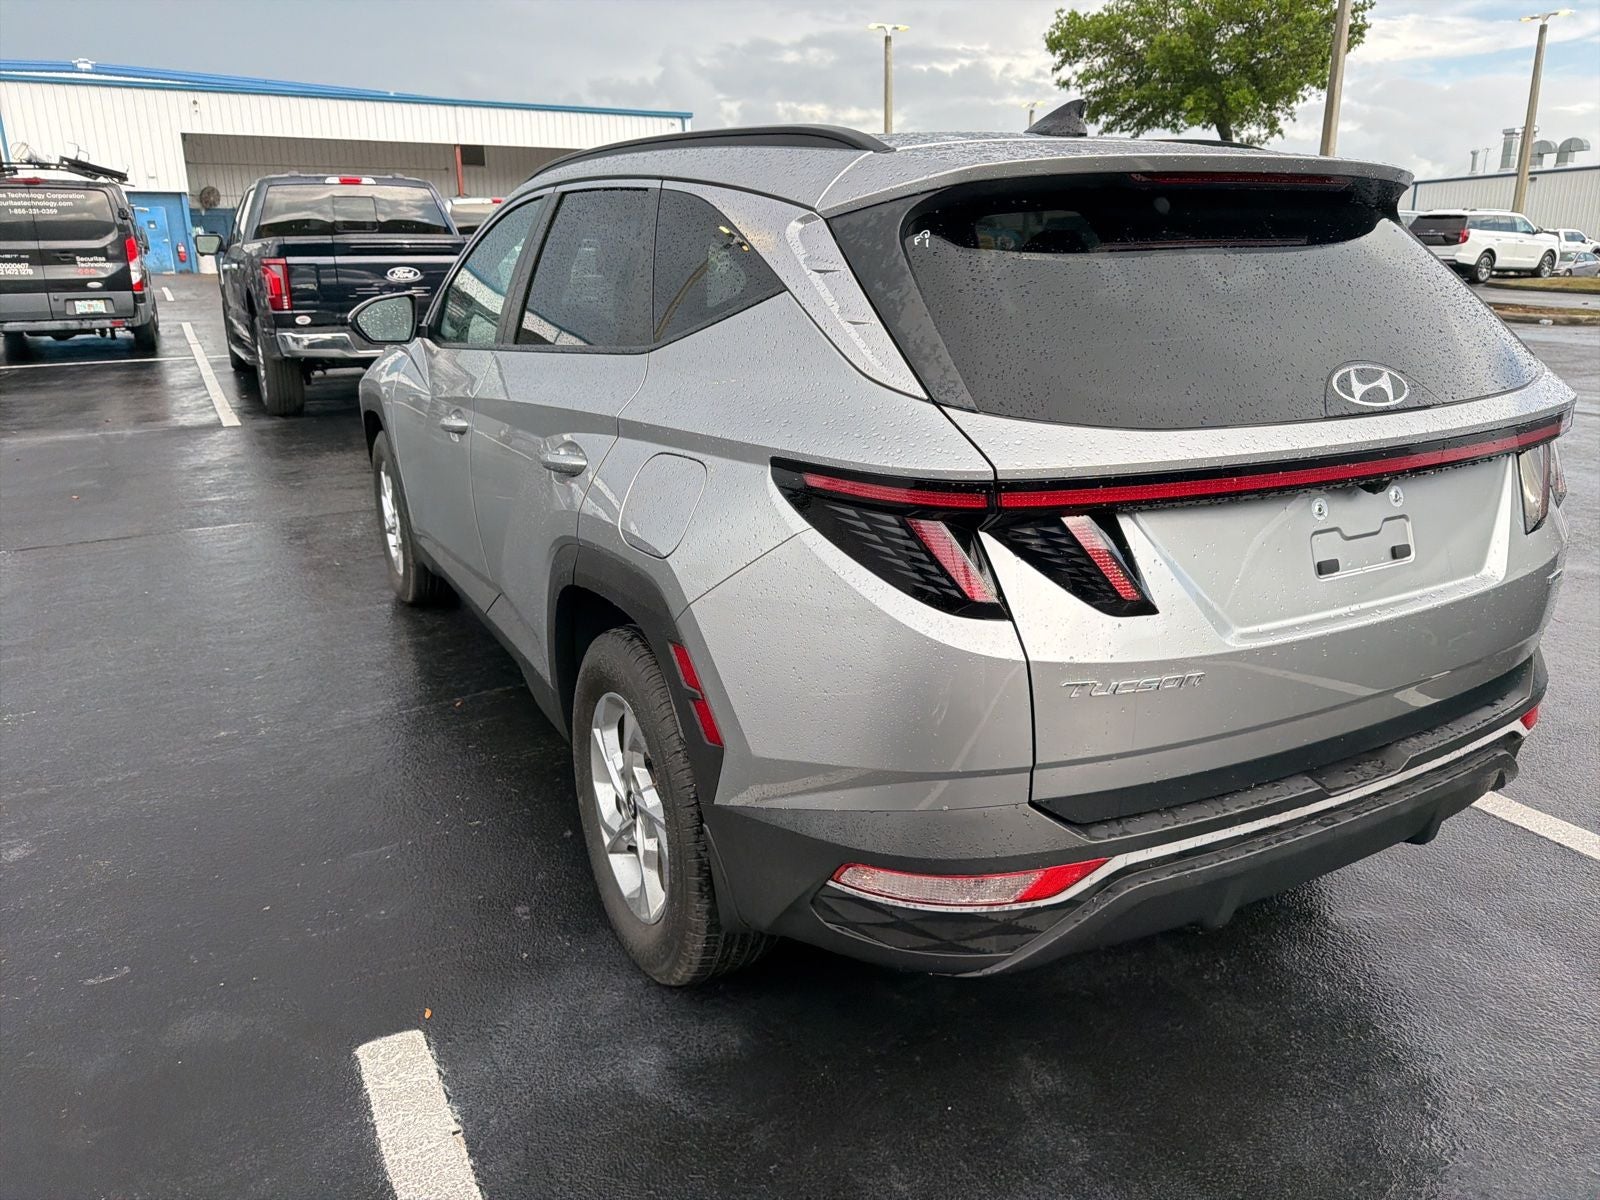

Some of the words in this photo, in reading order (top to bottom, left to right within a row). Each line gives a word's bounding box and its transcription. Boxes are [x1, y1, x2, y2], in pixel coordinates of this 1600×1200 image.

[46, 192, 85, 200] Corporation
[77, 261, 112, 269] Technology
[1060, 672, 1206, 699] TUCSON
